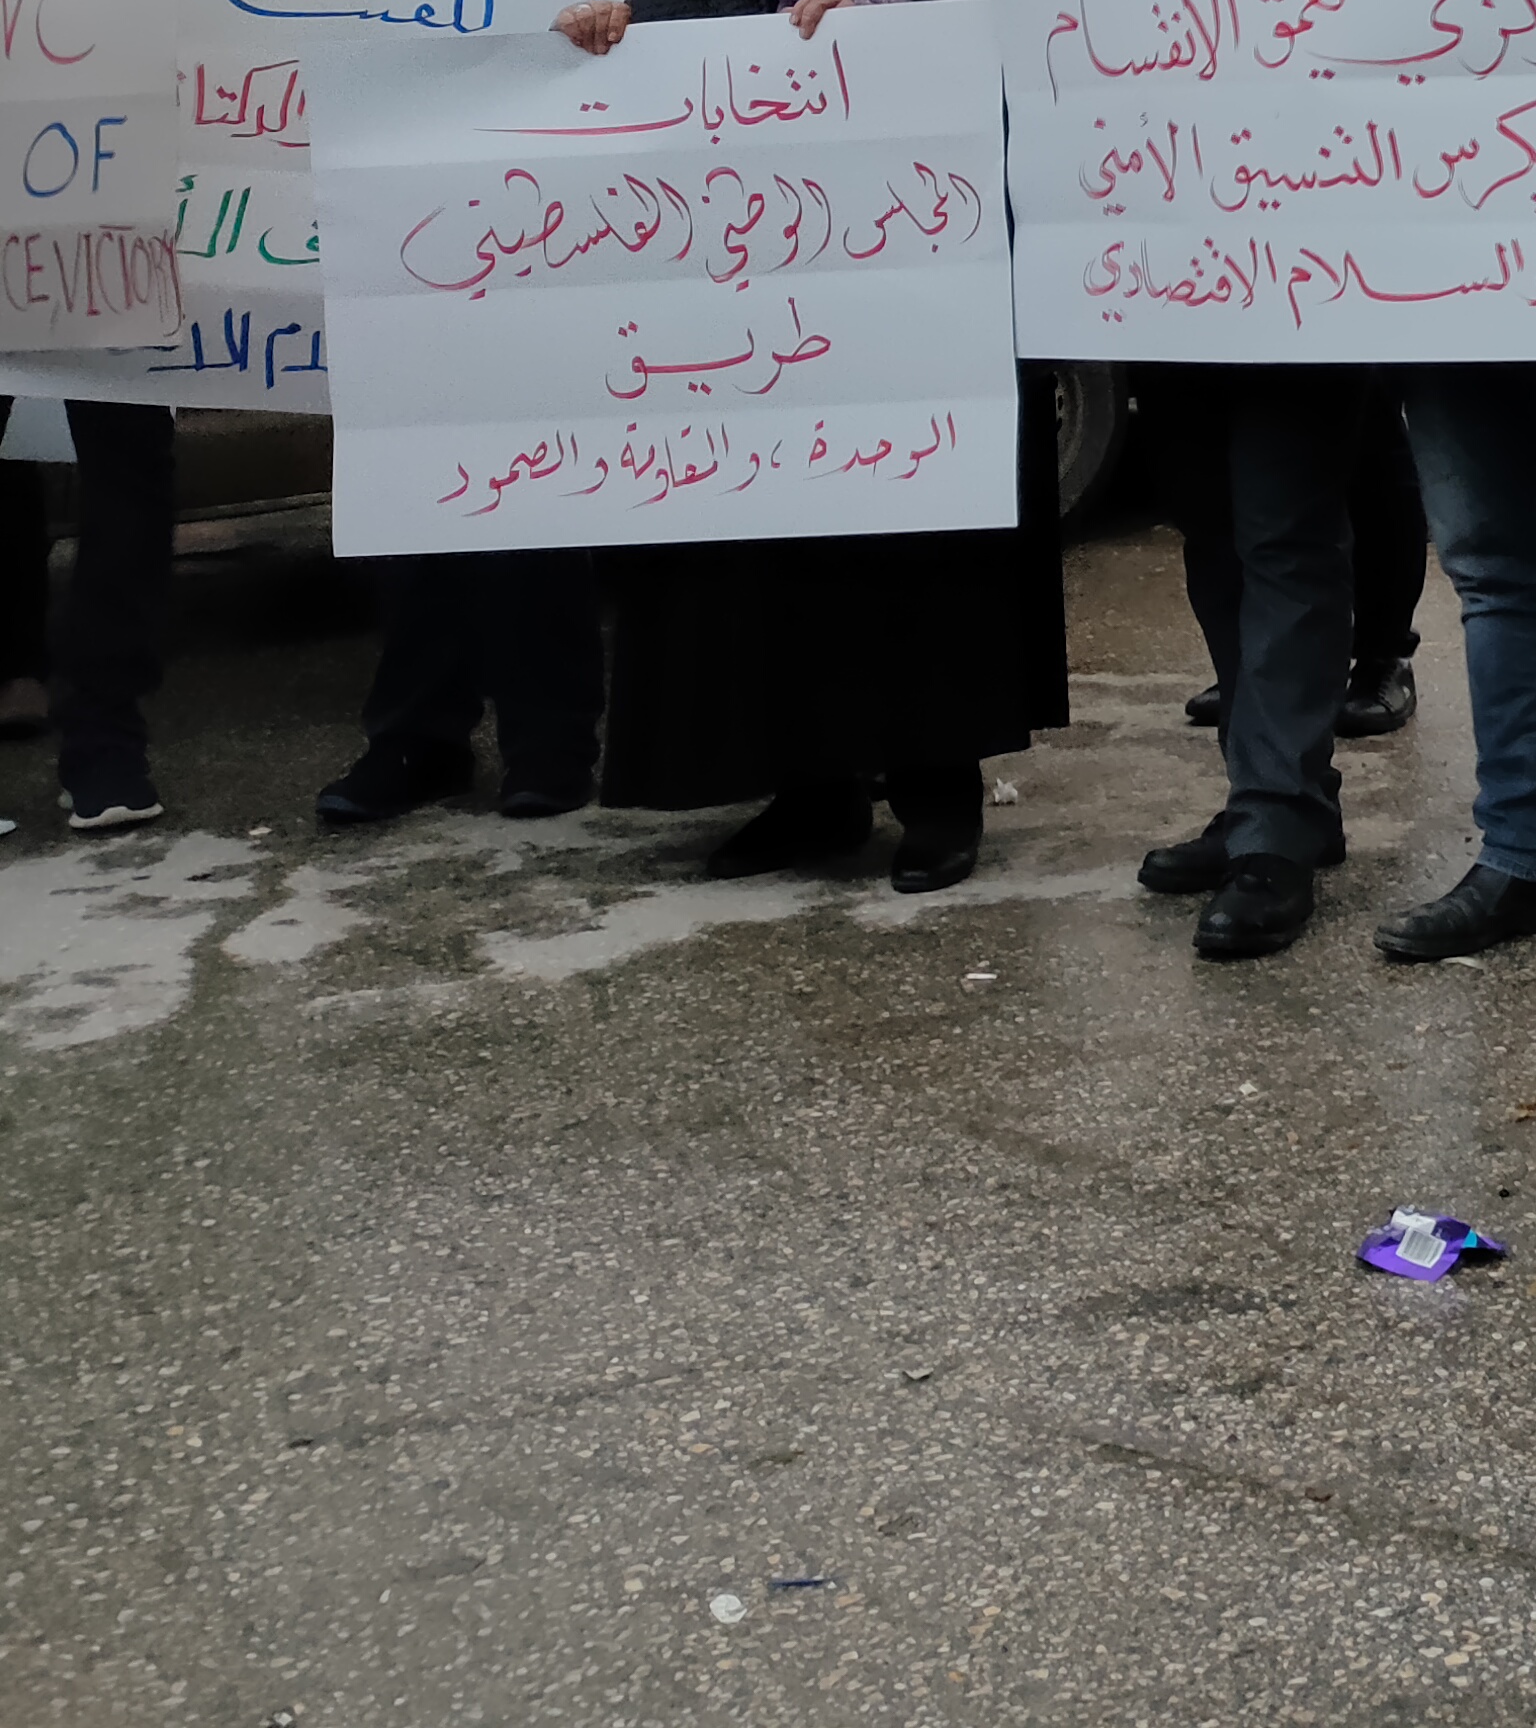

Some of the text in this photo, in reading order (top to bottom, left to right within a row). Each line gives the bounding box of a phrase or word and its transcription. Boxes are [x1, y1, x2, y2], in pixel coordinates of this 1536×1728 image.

[23, 116, 128, 198] OF
[1210, 119, 1403, 213] التنسيق
[399, 167, 695, 301] الفلسطيني
[605, 296, 832, 399] طريق
